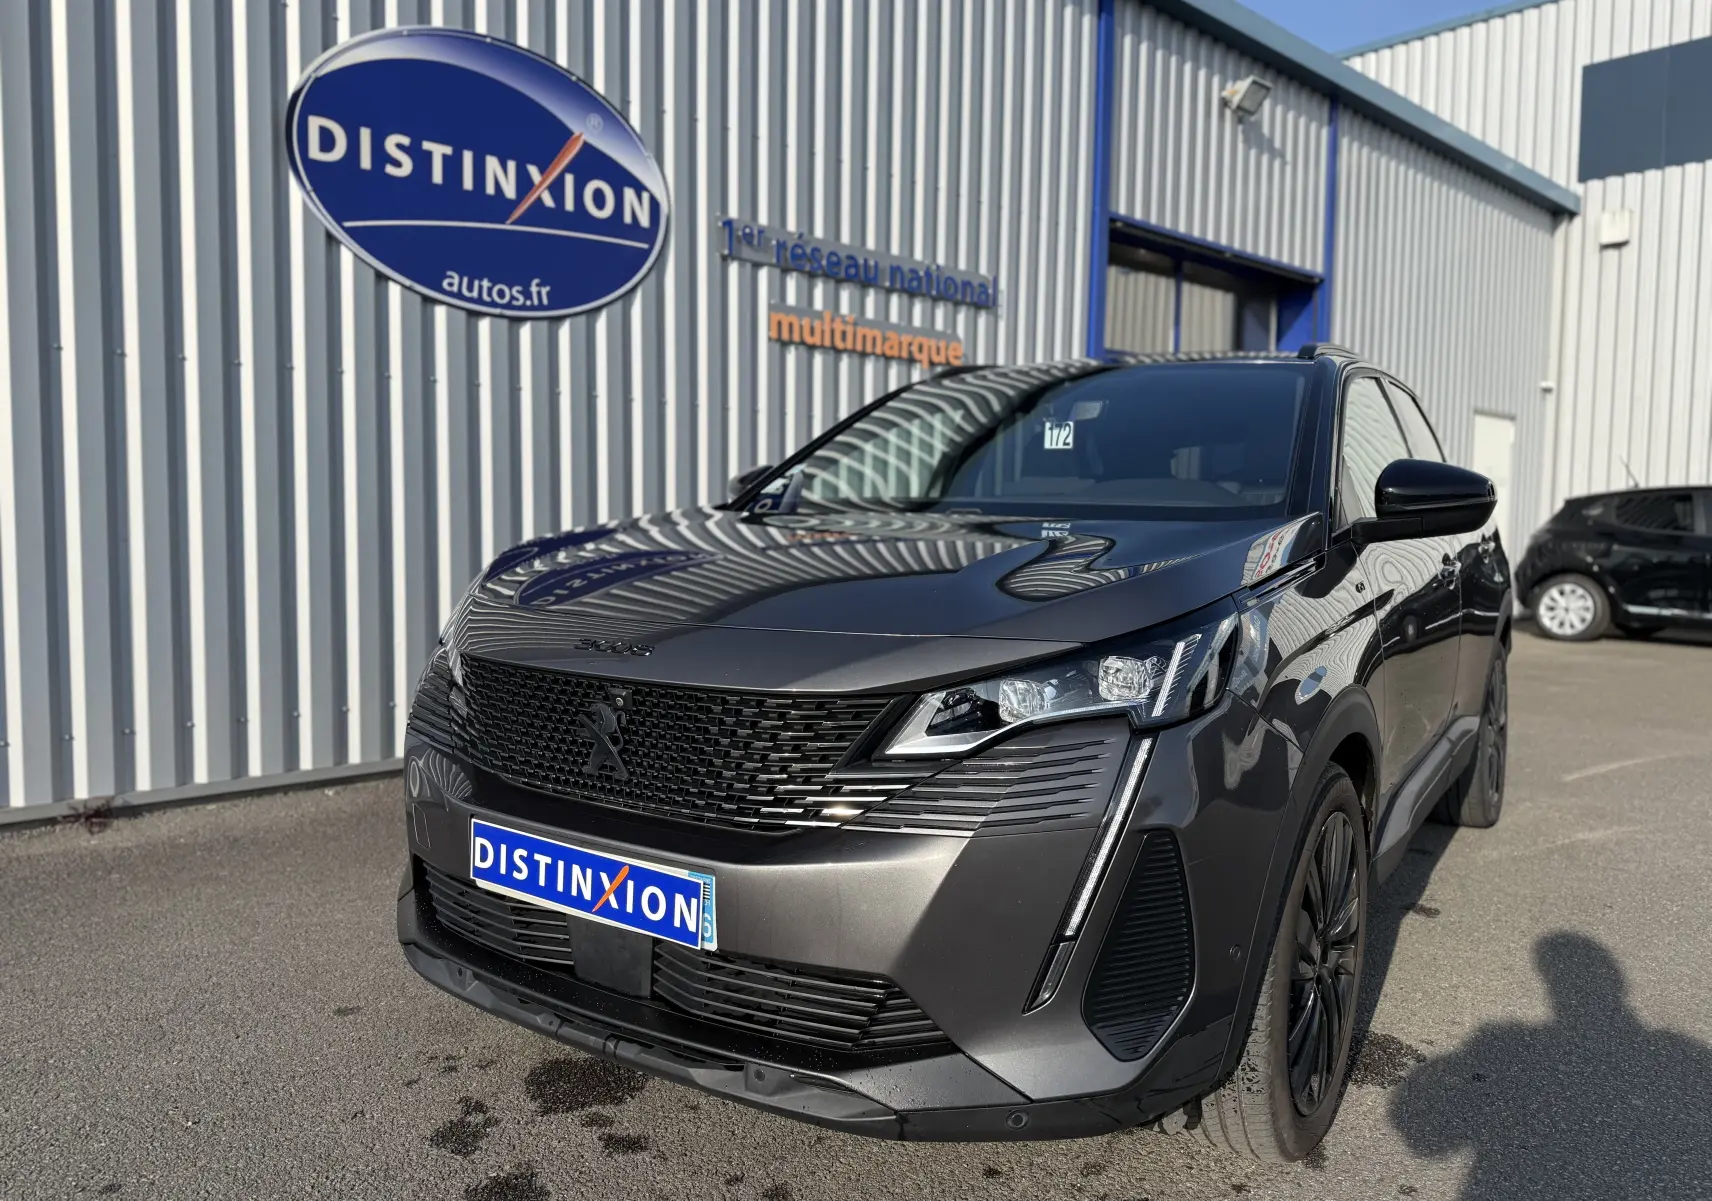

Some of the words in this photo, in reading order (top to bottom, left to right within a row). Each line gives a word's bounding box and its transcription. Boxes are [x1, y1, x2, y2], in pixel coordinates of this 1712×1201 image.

[307, 115, 651, 229] DISTINXION
[442, 270, 551, 307] autos.fr
[774, 232, 880, 283] réseau
[888, 263, 998, 308] national
[768, 310, 964, 370] multimarque
[1047, 422, 1073, 447] 172
[474, 836, 698, 933] DISTINXION
